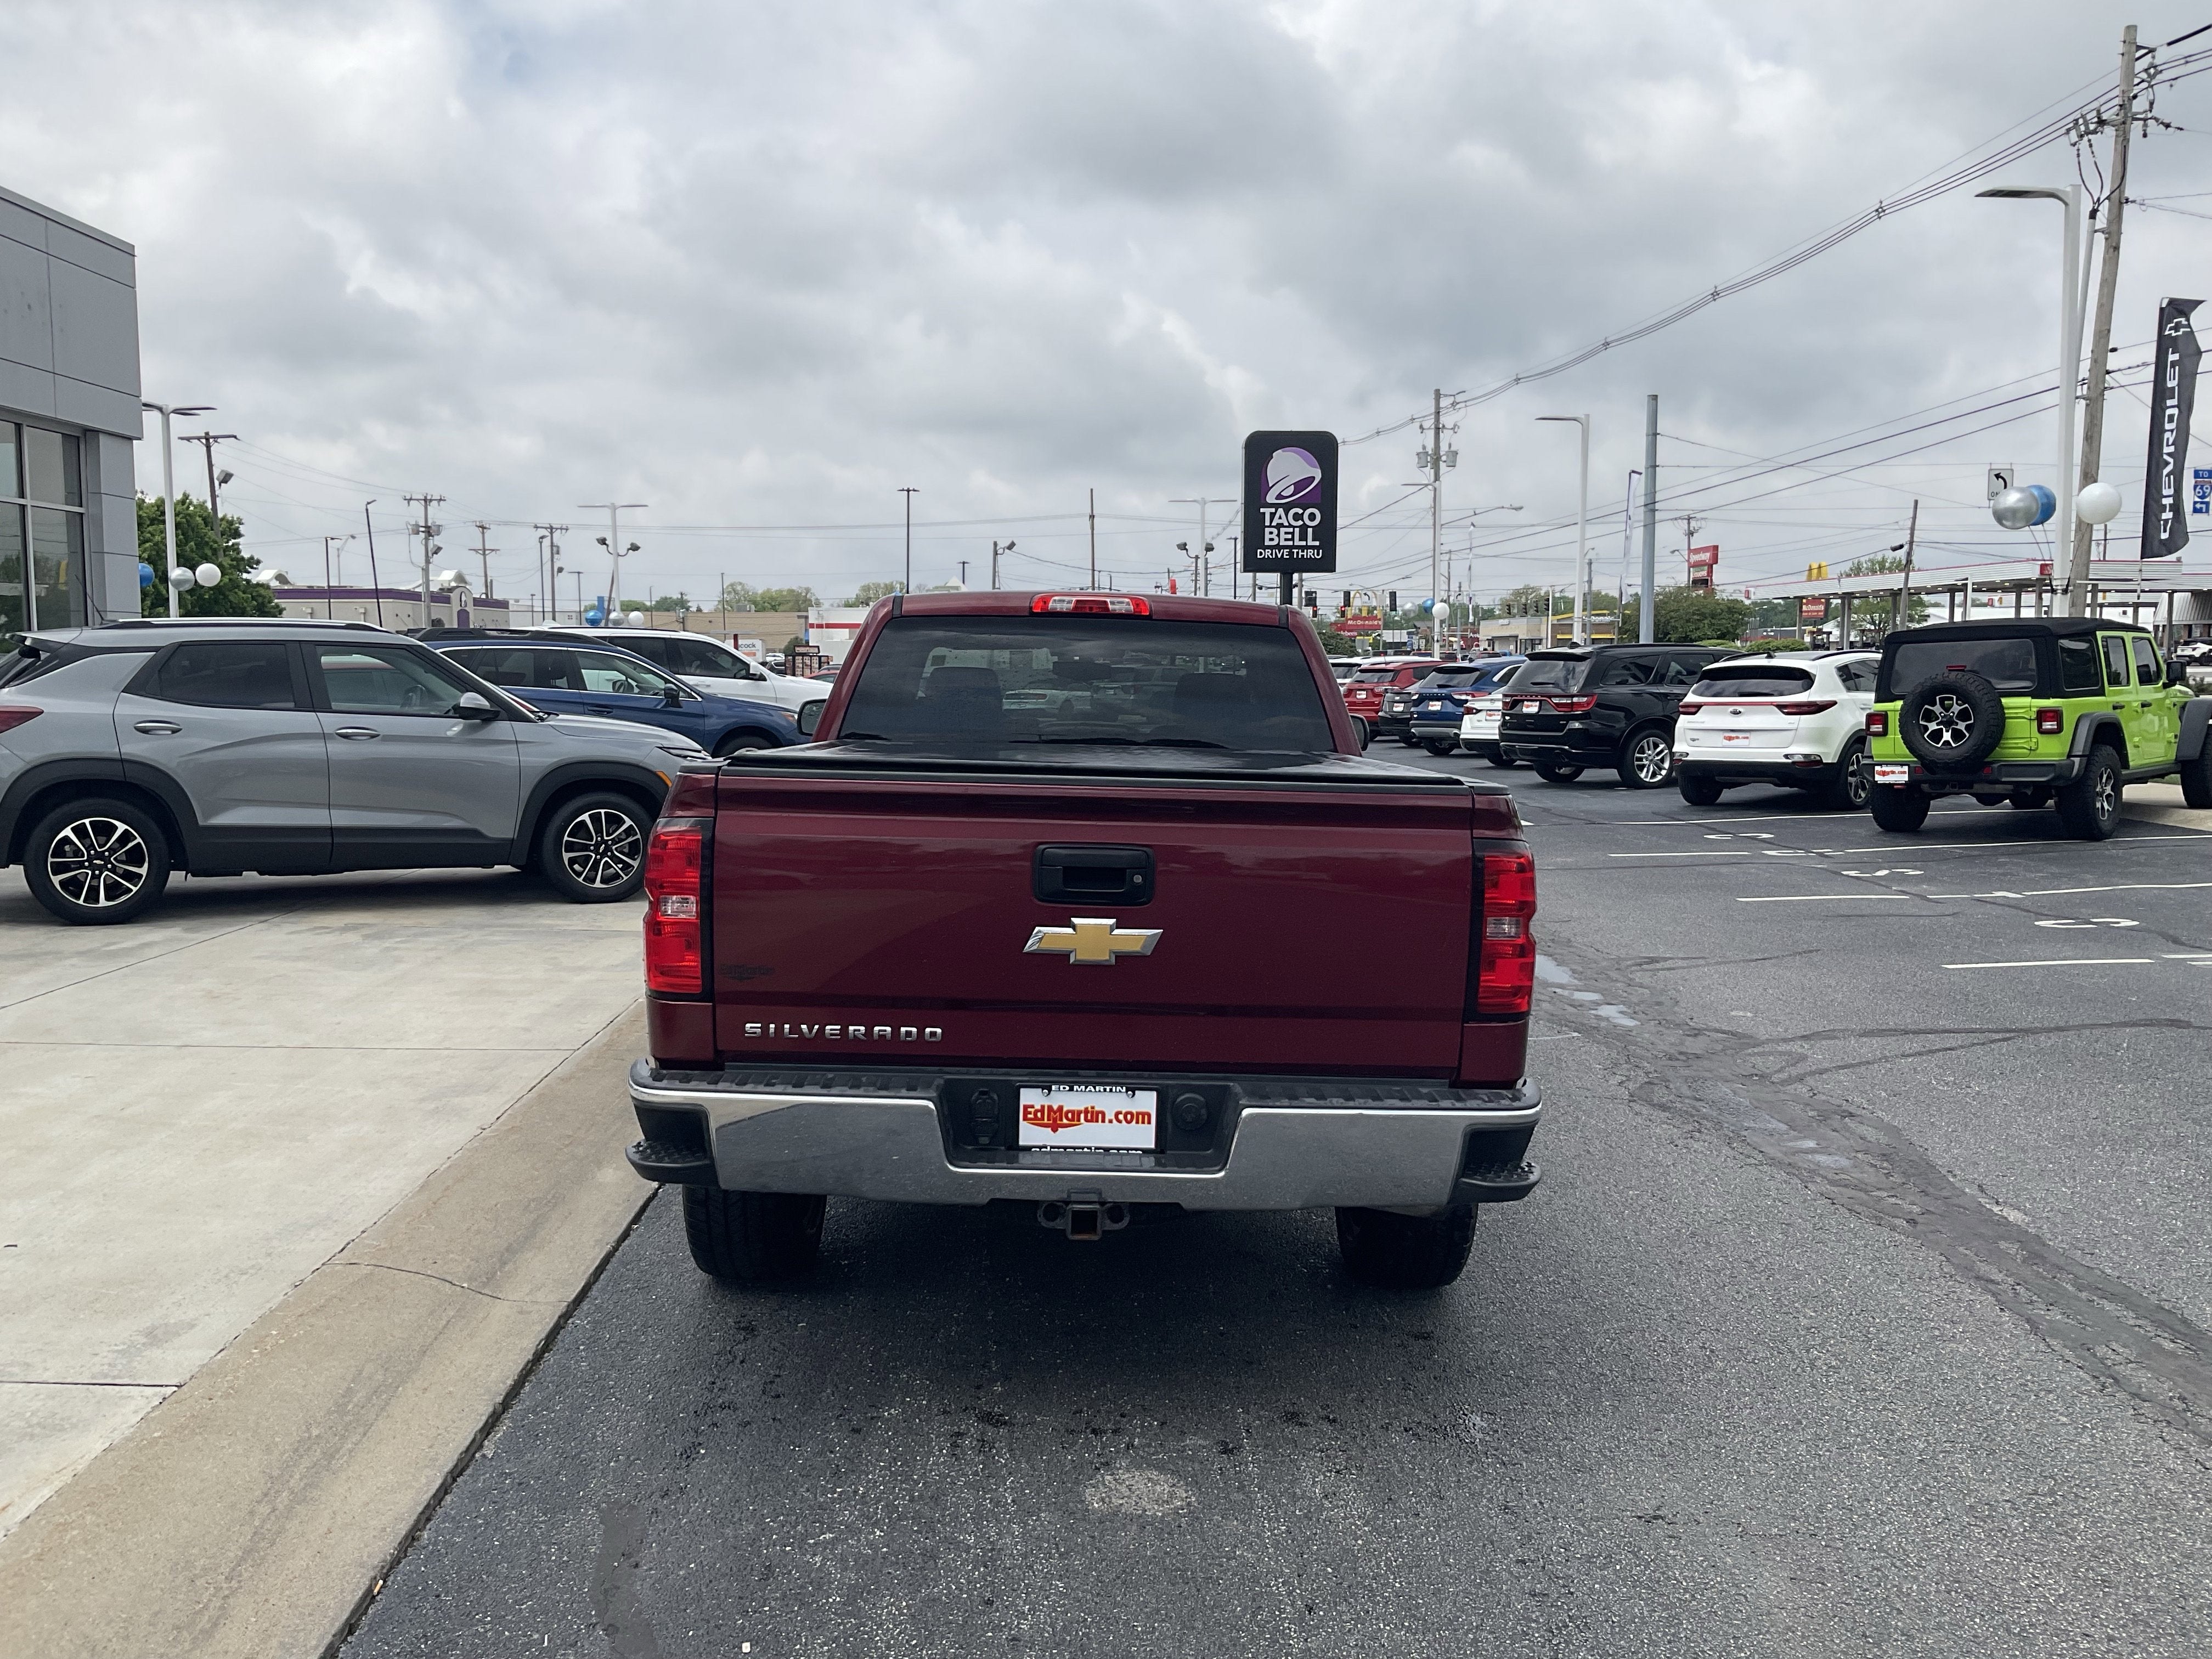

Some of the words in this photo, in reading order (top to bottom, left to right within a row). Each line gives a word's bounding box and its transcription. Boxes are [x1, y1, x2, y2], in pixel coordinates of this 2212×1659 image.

[2160, 348, 2180, 539] CHEVROLET
[2196, 485, 2210, 496] 69
[1260, 508, 1321, 526] TACO
[1264, 528, 1319, 546] BELL
[1257, 549, 1289, 558] DRIVE
[1292, 549, 1323, 558] THRU
[1690, 551, 1710, 565] Speedway
[744, 1023, 943, 1042] SILVERADO
[1022, 1104, 1152, 1126] EdMartin.com
